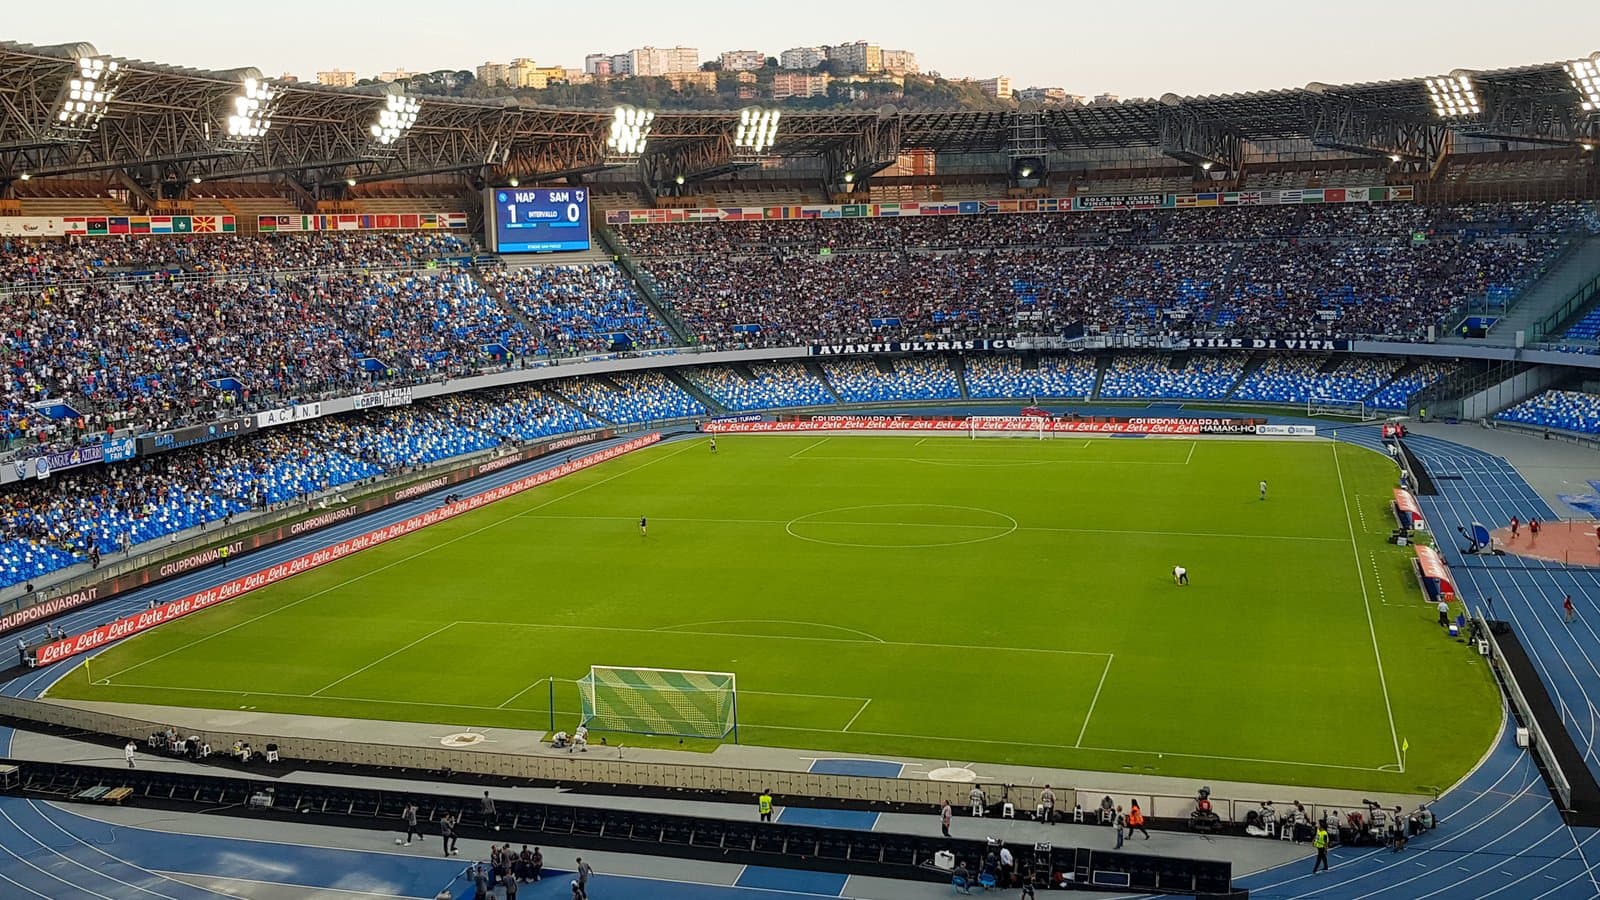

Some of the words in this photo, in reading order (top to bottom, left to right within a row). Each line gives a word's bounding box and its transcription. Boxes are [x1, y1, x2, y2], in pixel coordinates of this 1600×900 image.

[516, 192, 535, 202] NAP
[550, 192, 569, 202] SAM
[508, 204, 516, 223] 1
[568, 204, 580, 222] 0
[820, 344, 891, 354] AVANTI
[900, 341, 974, 350] ULTRAS
[1253, 340, 1276, 348] DI
[1285, 340, 1334, 349] VITA
[384, 386, 412, 398] APULIA
[704, 424, 726, 432] Lete
[727, 423, 749, 431] Lete
[751, 423, 772, 431] Lete
[773, 422, 795, 430] Lete
[797, 422, 818, 430] Lete
[819, 421, 840, 429] Lete
[842, 421, 864, 429] Lete
[865, 421, 886, 429] Lete
[887, 421, 908, 429] Lete
[911, 421, 932, 429] Lete
[935, 421, 956, 429] Lete
[982, 422, 1003, 430] Lete
[1005, 422, 1026, 430] Lete
[1052, 422, 1074, 430] Lete
[1076, 423, 1098, 431] Lete
[1101, 423, 1124, 431] Lete
[1126, 424, 1148, 432] Lete
[1175, 425, 1198, 433] Lete
[1200, 424, 1255, 432] HAMAKI-HO
[549, 434, 596, 450] GRUPPONAVARRA.IT
[479, 453, 522, 473] GRUPPONAVARRA.IT
[395, 477, 448, 500] GRUPPONAVARRA.IT
[291, 506, 357, 534] GRUPPONAVARRA.IT
[40, 641, 71, 663] Lete
[74, 629, 104, 652] Lete
[106, 620, 134, 640] Lete
[136, 610, 162, 629] Lete
[164, 600, 190, 618] Lete
[192, 591, 216, 609] Lete
[217, 582, 240, 600] Lete
[242, 574, 264, 591] Lete
[266, 565, 287, 582] Lete
[288, 558, 309, 574] Lete
[311, 550, 330, 566] Lete
[332, 543, 350, 558] Lete
[350, 536, 368, 551] Lete
[370, 530, 387, 545] Lete
[389, 524, 405, 538] Lete
[406, 517, 421, 532] Lete
[422, 512, 438, 526] Lete
[439, 506, 454, 520] Lete
[454, 501, 468, 514] Lete
[469, 497, 482, 509] Lete
[483, 491, 497, 503] Lete
